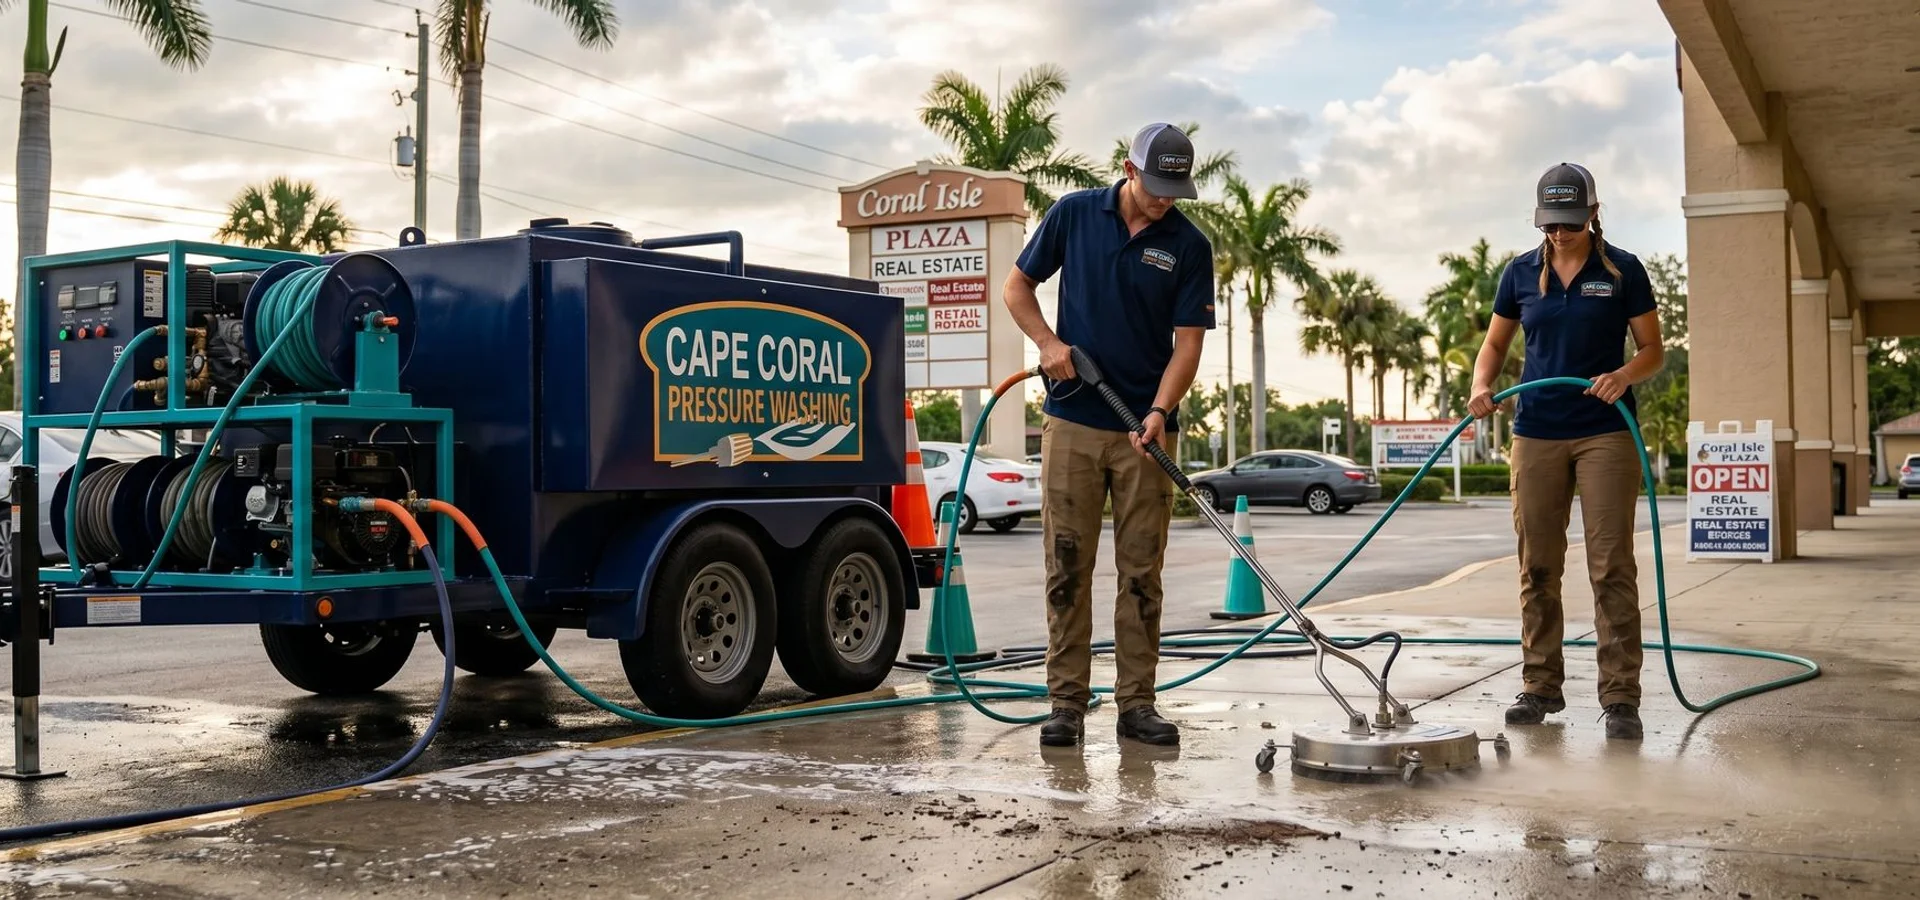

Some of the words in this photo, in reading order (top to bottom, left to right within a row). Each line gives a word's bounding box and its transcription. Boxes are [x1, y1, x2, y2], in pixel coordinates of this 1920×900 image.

[857, 181, 931, 218] Coral
[933, 177, 983, 212] Isle
[886, 226, 972, 250] PLAZA
[875, 260, 917, 277] REAL
[922, 256, 983, 274] ESTATE
[930, 284, 951, 294] Real
[934, 309, 981, 320] RETAIL
[666, 326, 750, 379] CAPE
[757, 334, 851, 385] CORAL
[668, 385, 765, 424] PRESSURE
[769, 390, 851, 426] WASHING
[1701, 443, 1737, 453] Coral
[1742, 442, 1765, 453] Isle
[1722, 454, 1760, 462] PLAZA
[1694, 467, 1766, 490] OPEN
[1711, 495, 1747, 504] REAL
[1706, 506, 1758, 516] ESTATE
[1695, 521, 1723, 529] REAL
[1725, 521, 1766, 529] ESTATE
